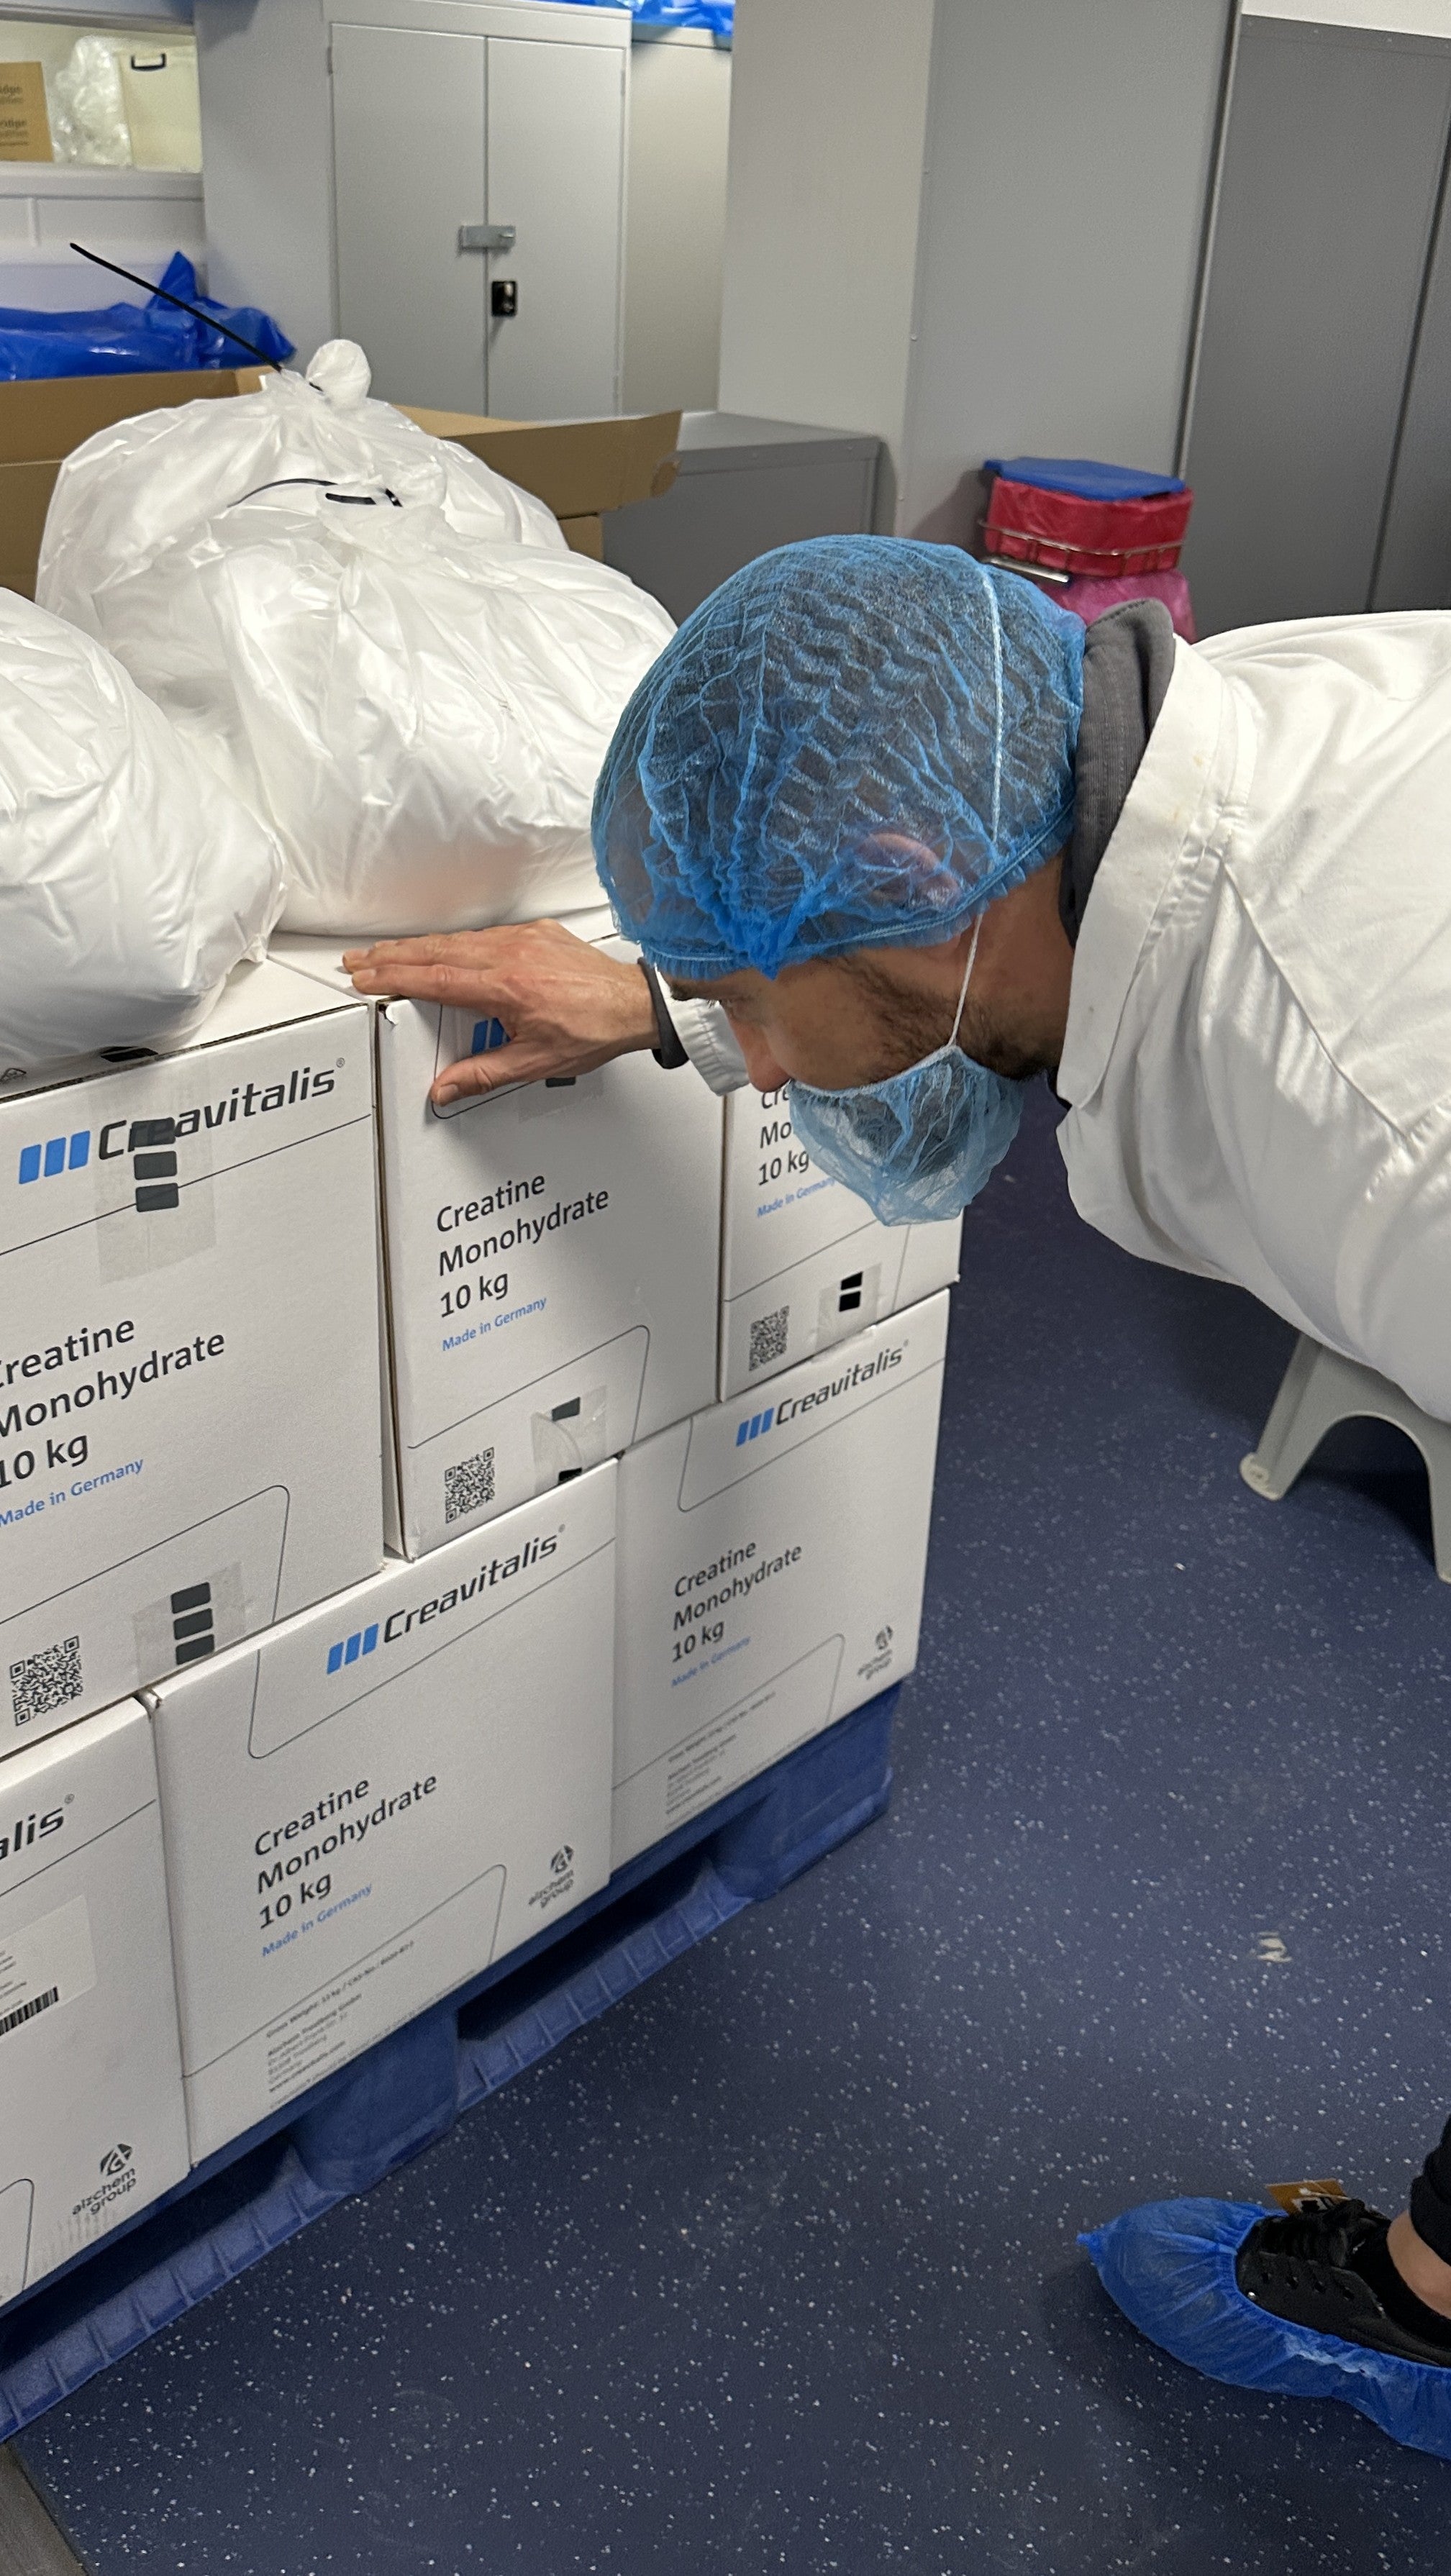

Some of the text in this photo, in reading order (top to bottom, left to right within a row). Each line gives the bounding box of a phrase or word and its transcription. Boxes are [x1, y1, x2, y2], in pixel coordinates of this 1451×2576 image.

[758, 1150, 809, 1185] 10 kg
[437, 1175, 545, 1232] Creatine
[440, 1191, 609, 1277] Monohydrate
[440, 1273, 508, 1318] 10 kg
[442, 1297, 547, 1352] Made in Germany
[0, 1320, 135, 1388] reatine
[46, 1434, 88, 1469] kg
[50, 1491, 66, 1506] in
[70, 1458, 144, 1497] Germany
[673, 1546, 802, 1631] Monohydrate
[674, 1542, 756, 1598] Creatine
[672, 1621, 724, 1663] 10 kg
[255, 1780, 369, 1856] Creatine
[258, 1775, 437, 1894] Monohydrate
[260, 1873, 332, 1929] 10 kg
[262, 1883, 373, 1957] Made in Germany
[73, 2168, 136, 2216] alzchem
[89, 2177, 137, 2216] group
